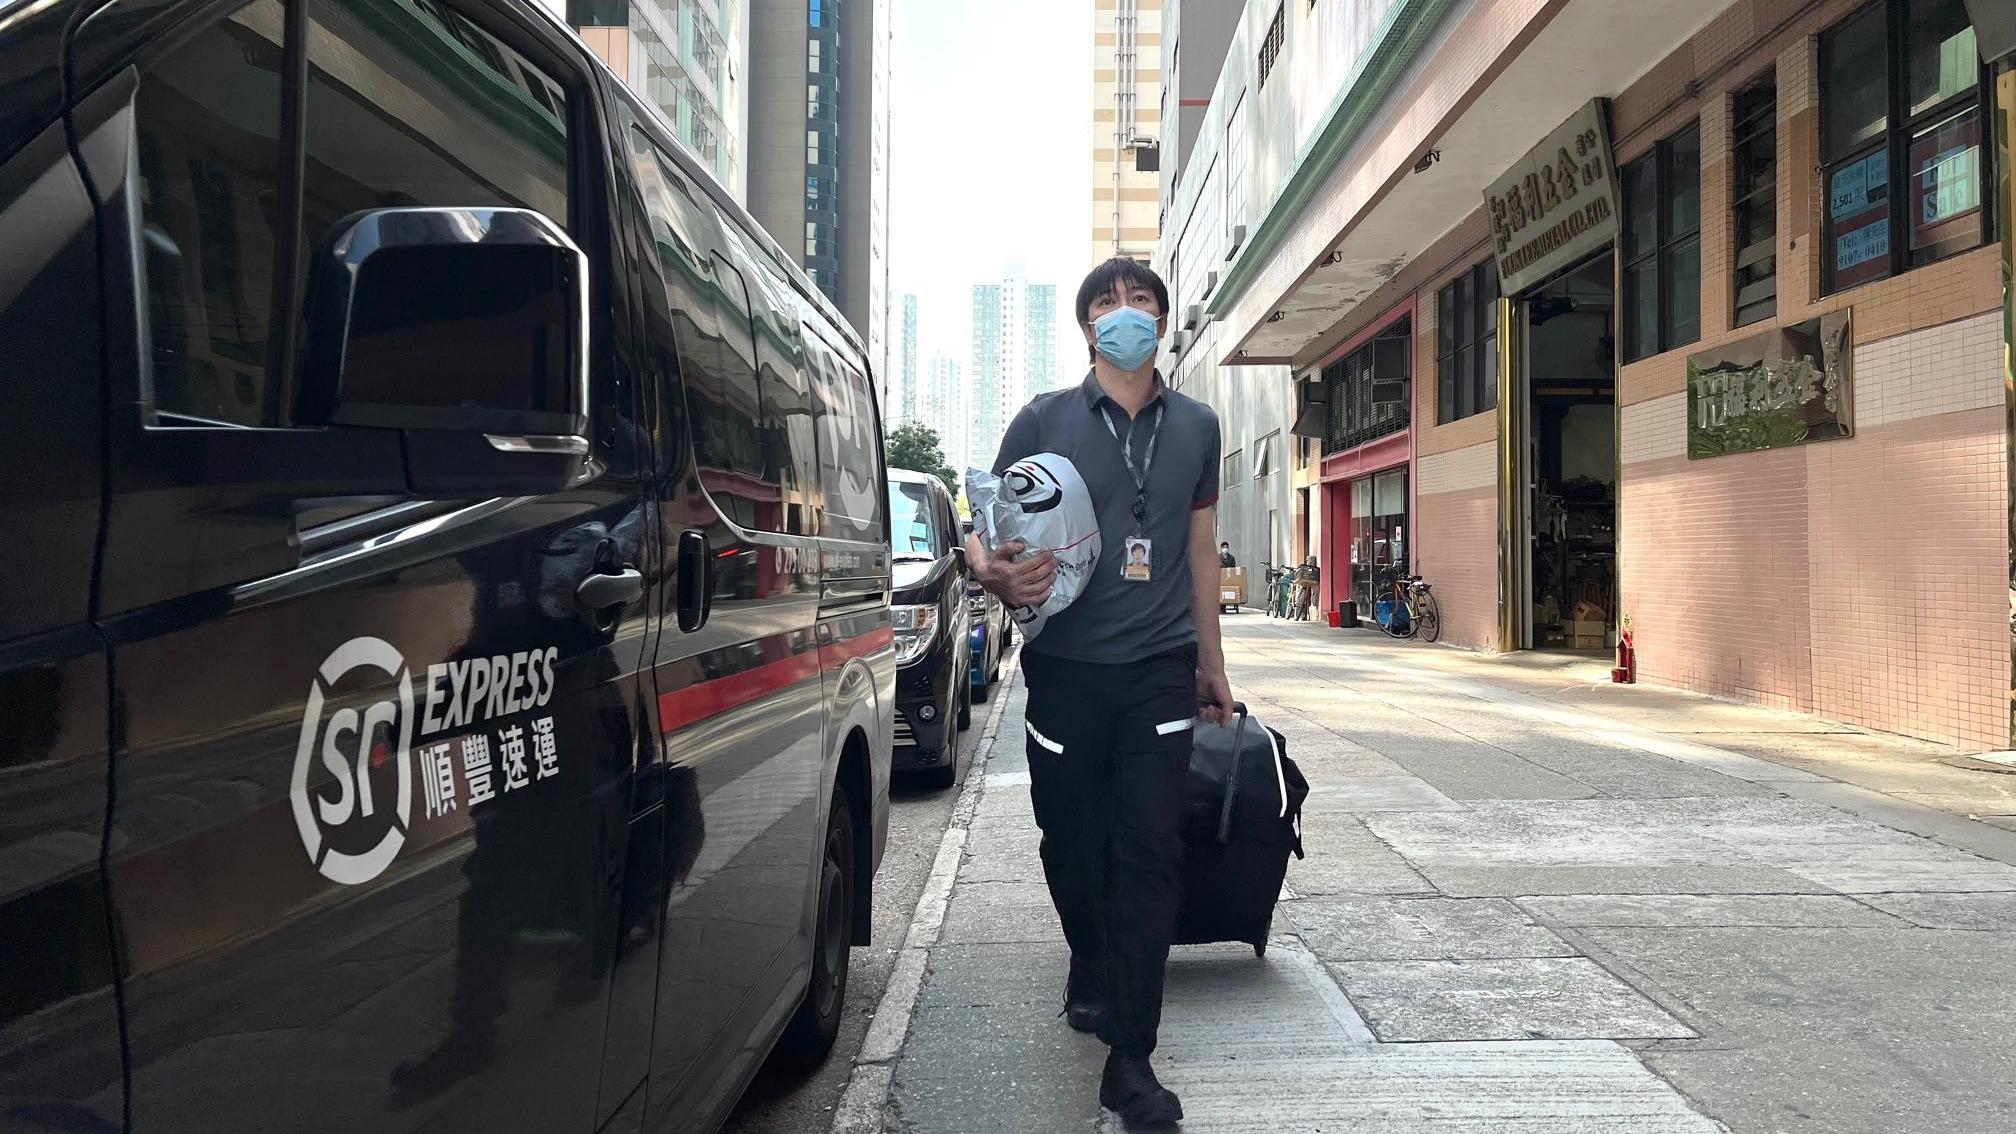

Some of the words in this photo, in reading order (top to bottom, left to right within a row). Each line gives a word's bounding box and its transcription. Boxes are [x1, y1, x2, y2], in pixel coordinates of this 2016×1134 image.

[1926, 186, 1965, 218] Sale
[1842, 235, 1857, 249] Tel:
[421, 646, 558, 736] EXPRESS
[419, 716, 559, 821] 順豐速運
